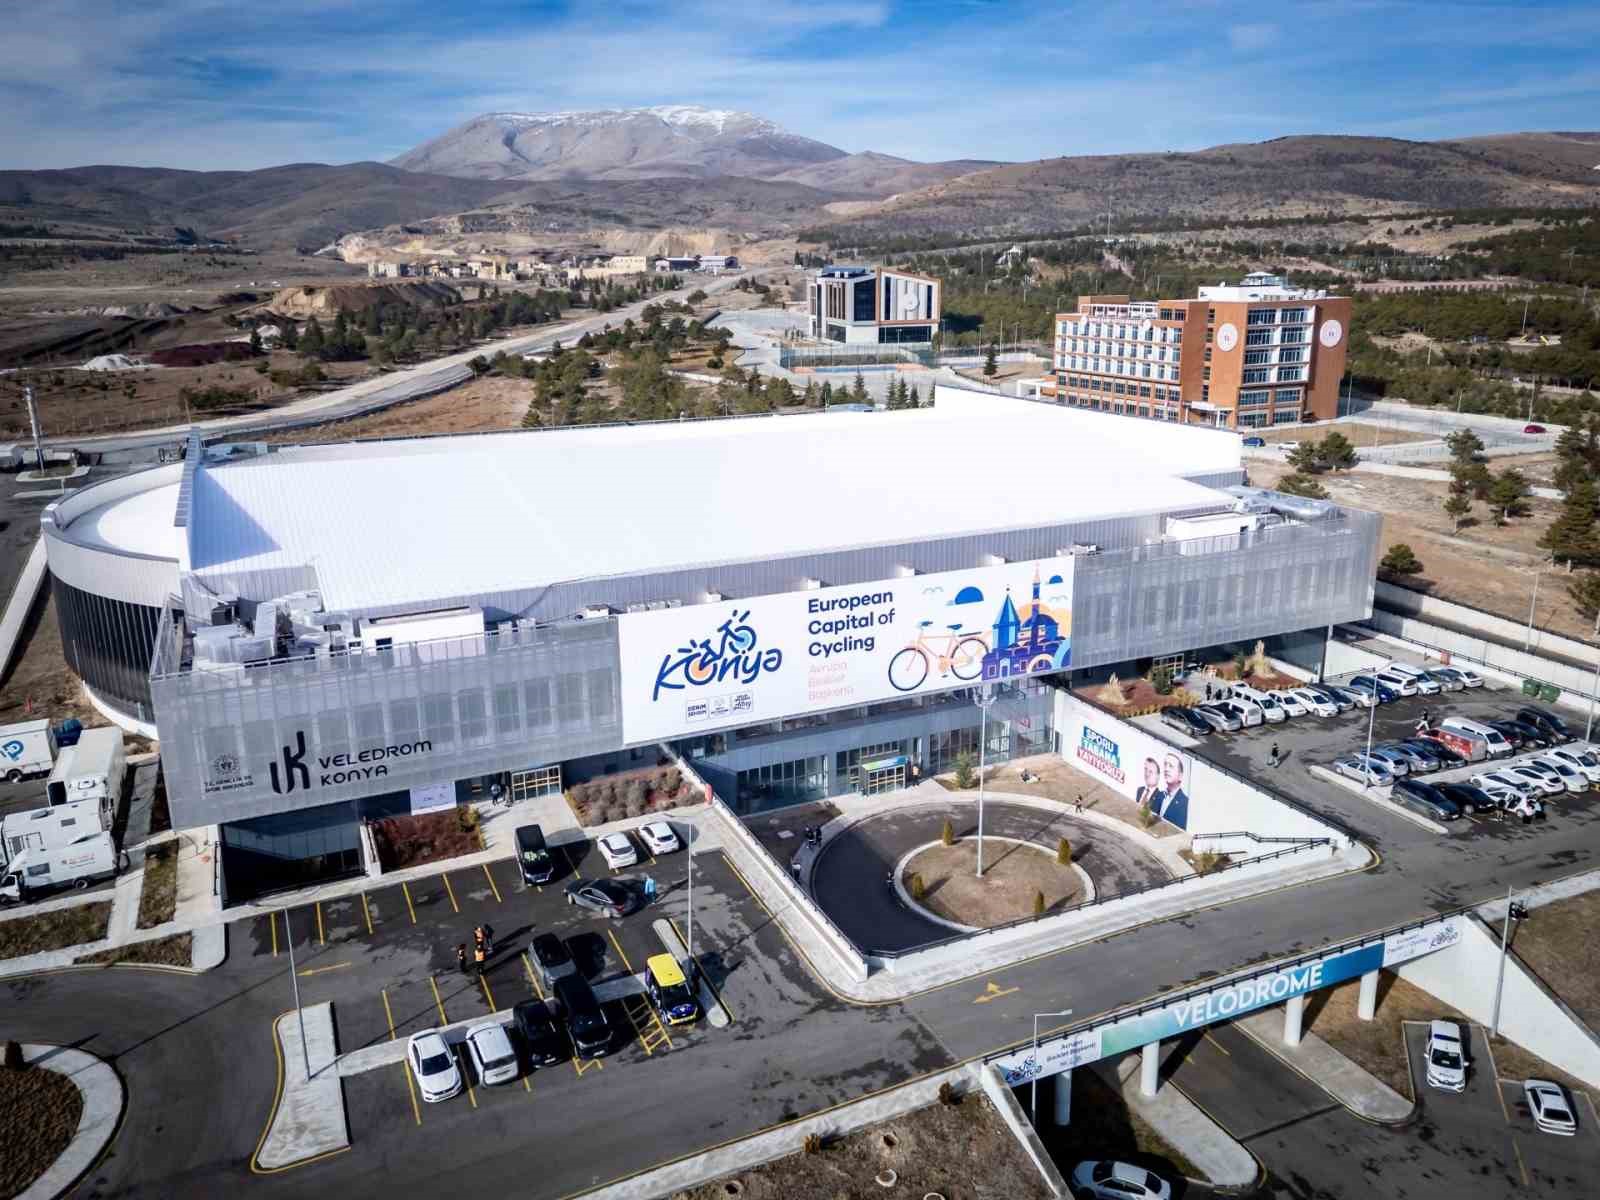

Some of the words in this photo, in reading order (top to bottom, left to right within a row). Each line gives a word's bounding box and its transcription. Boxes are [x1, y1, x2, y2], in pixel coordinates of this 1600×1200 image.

[808, 591, 894, 614] European
[808, 611, 874, 635] Capital
[878, 608, 896, 625] of
[808, 636, 875, 658] Cycling
[653, 632, 783, 702] Konya
[1086, 729, 1115, 752] SPORU
[318, 740, 433, 769] VELEDROM
[320, 765, 388, 787] KONYA
[1173, 963, 1324, 1028] VELODROME
